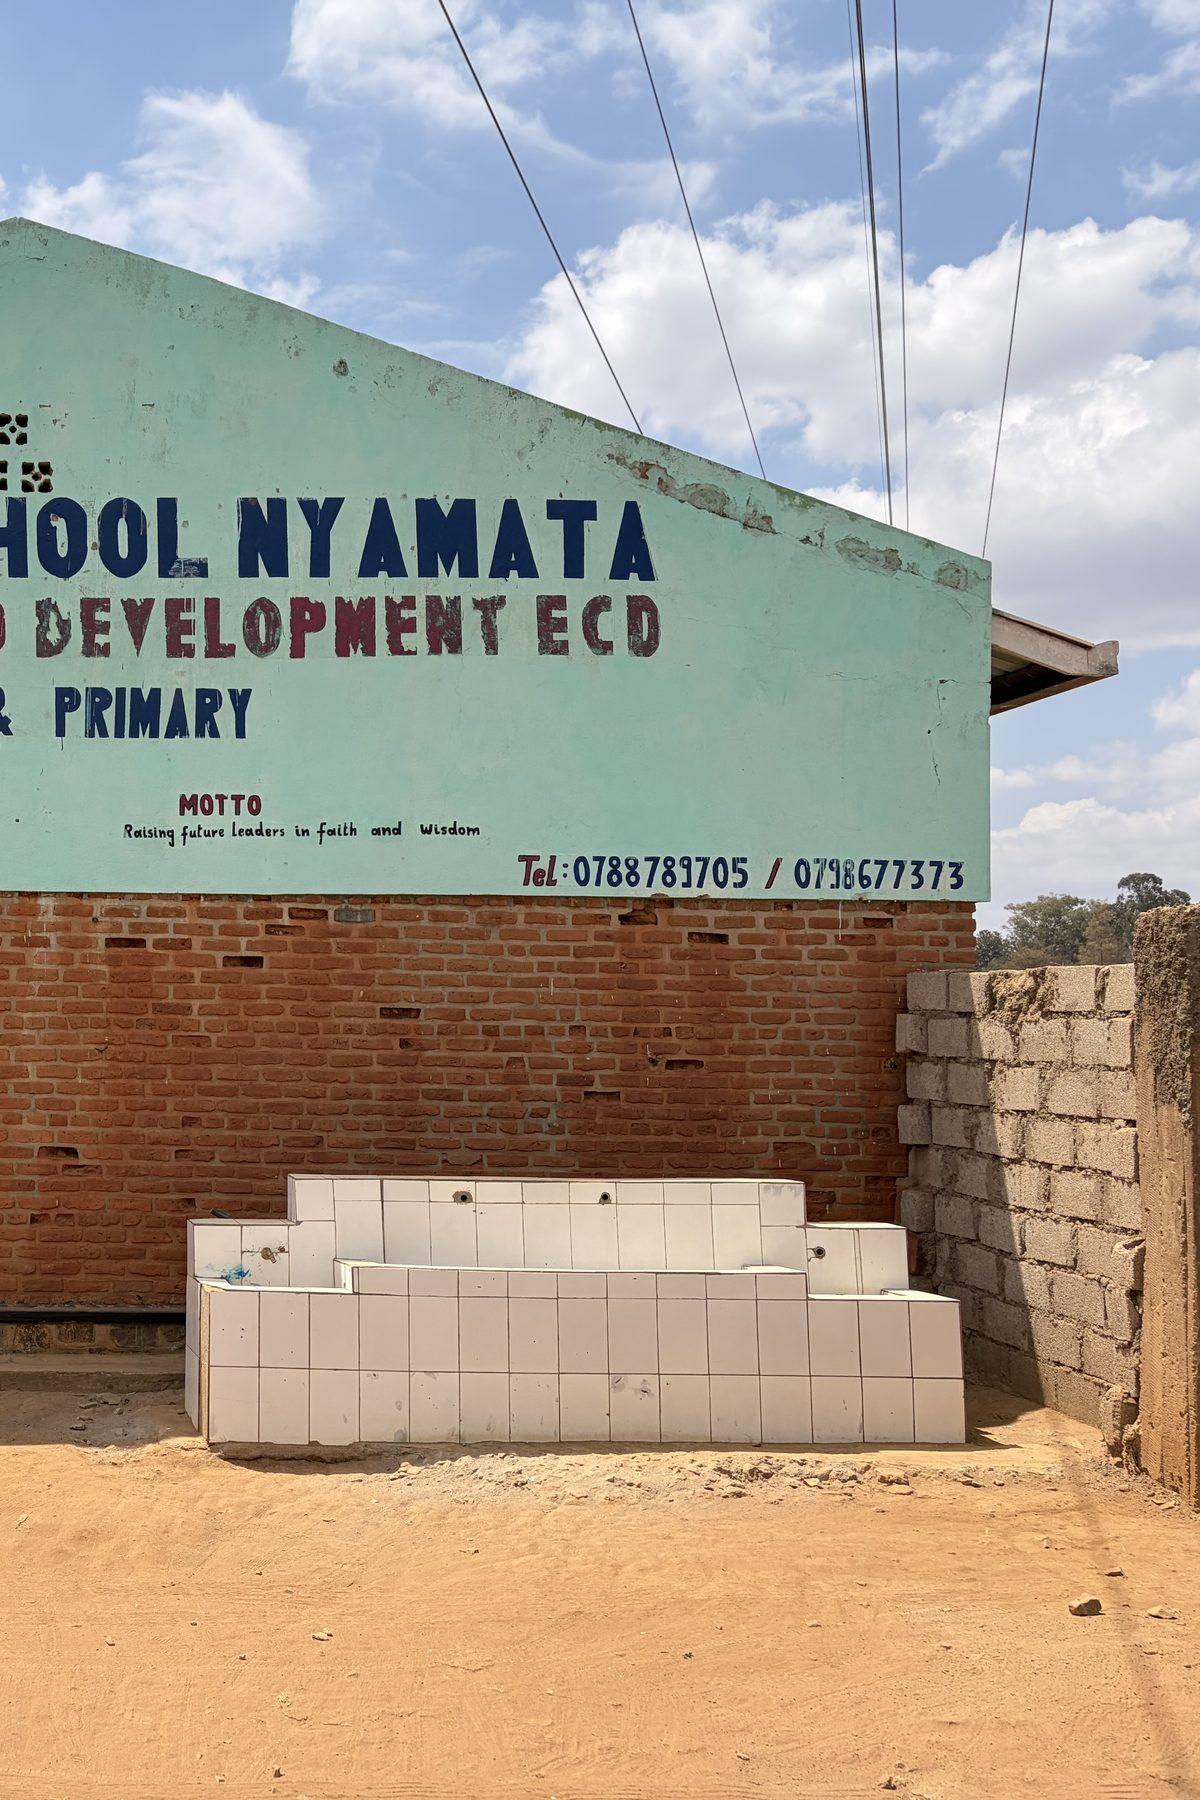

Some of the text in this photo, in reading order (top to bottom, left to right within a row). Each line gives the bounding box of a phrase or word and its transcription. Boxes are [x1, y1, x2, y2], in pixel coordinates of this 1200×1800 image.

[237, 497, 655, 582] NYAMATA
[36, 595, 506, 659] DEVELOPMENT
[536, 595, 660, 657] ECD
[55, 687, 252, 739] PRIMARY
[179, 794, 261, 816] MOTTO
[123, 823, 174, 847] Raising
[181, 825, 224, 846] future
[295, 826, 309, 836] in
[317, 822, 356, 845] faith
[371, 821, 401, 836] and
[574, 856, 748, 888] 0788789705
[765, 858, 782, 889] /
[794, 858, 963, 889] 0798677373
